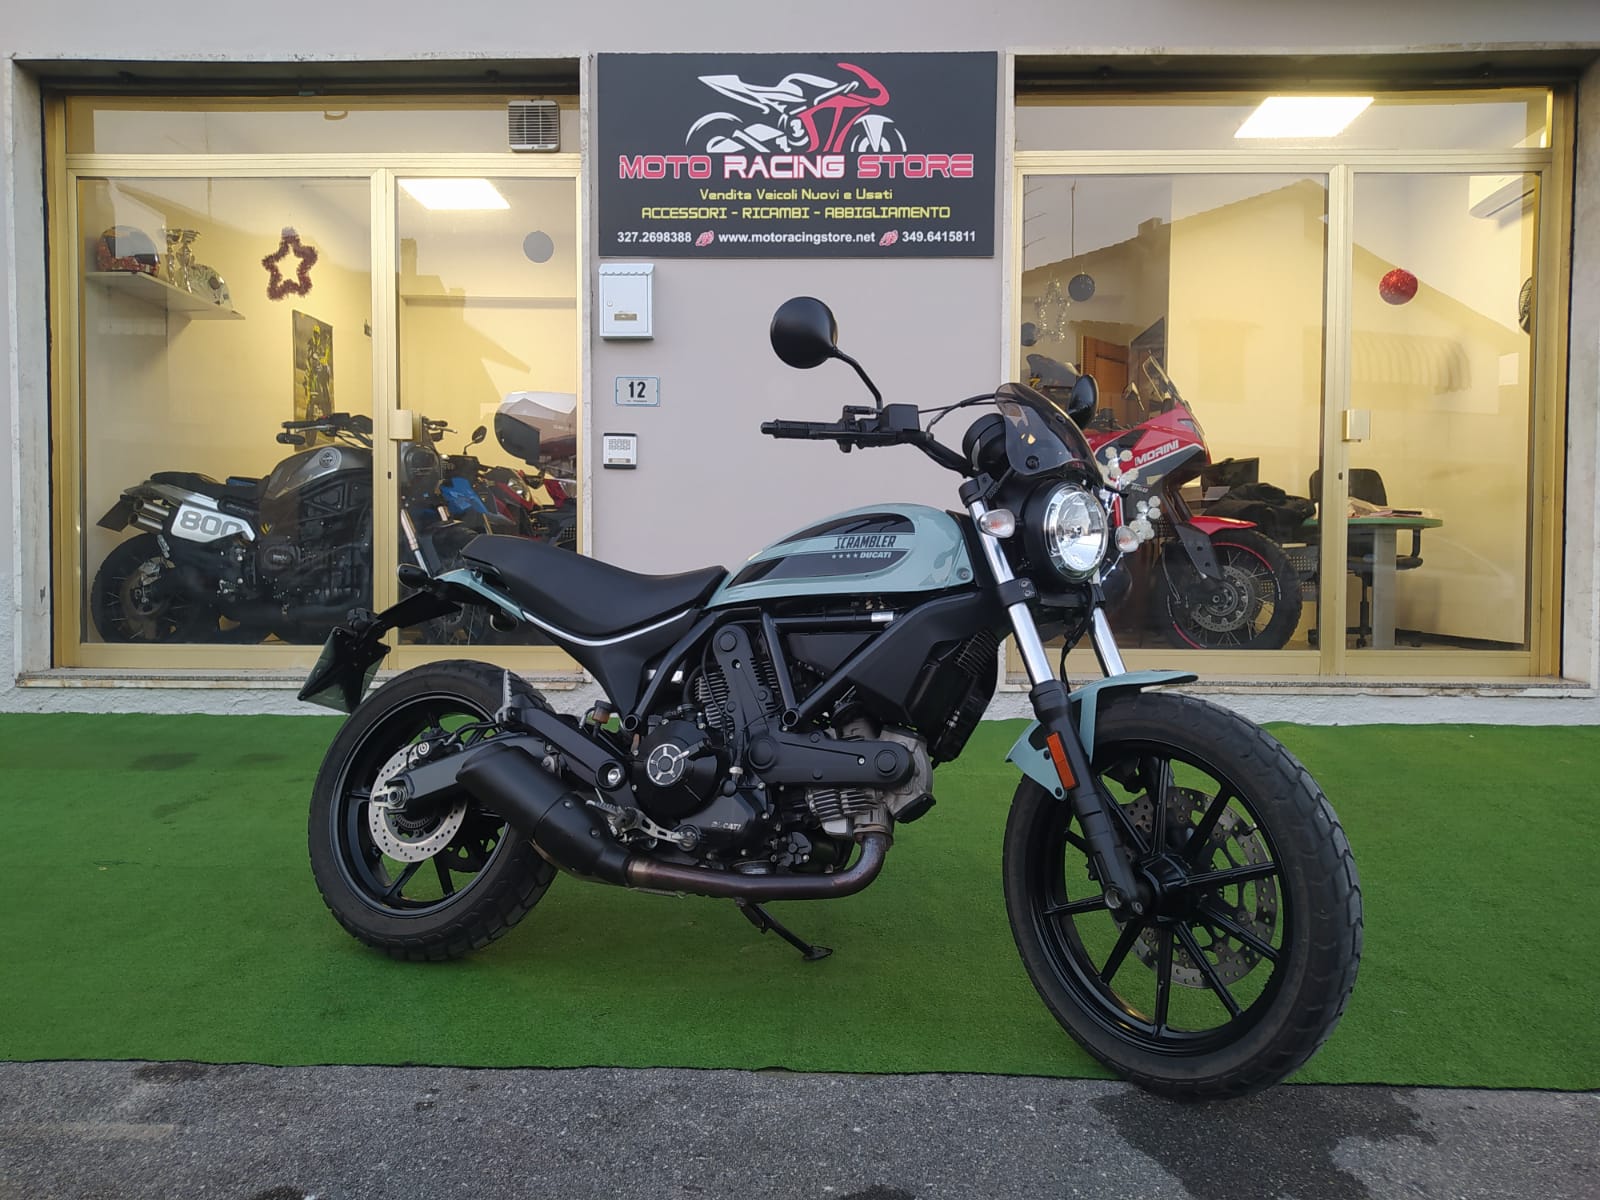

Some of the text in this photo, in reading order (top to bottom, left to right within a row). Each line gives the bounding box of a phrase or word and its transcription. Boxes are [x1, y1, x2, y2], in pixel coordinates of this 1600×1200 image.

[619, 153, 974, 179] MOTO RACING STORE
[699, 188, 893, 200] Vendita Veicoli Nuovi e Usati
[641, 207, 728, 219] ACCESSORI
[742, 207, 810, 219] RICAMBI
[824, 206, 951, 219] ABBIGLIAMENTO
[617, 230, 976, 245] 327.2698388 www.motoracingstore.net 349.6415811
[628, 381, 646, 398] 12
[1134, 439, 1180, 467] MORINI
[834, 535, 897, 549] SCRAMBLER
[859, 551, 892, 559] DUCATI
